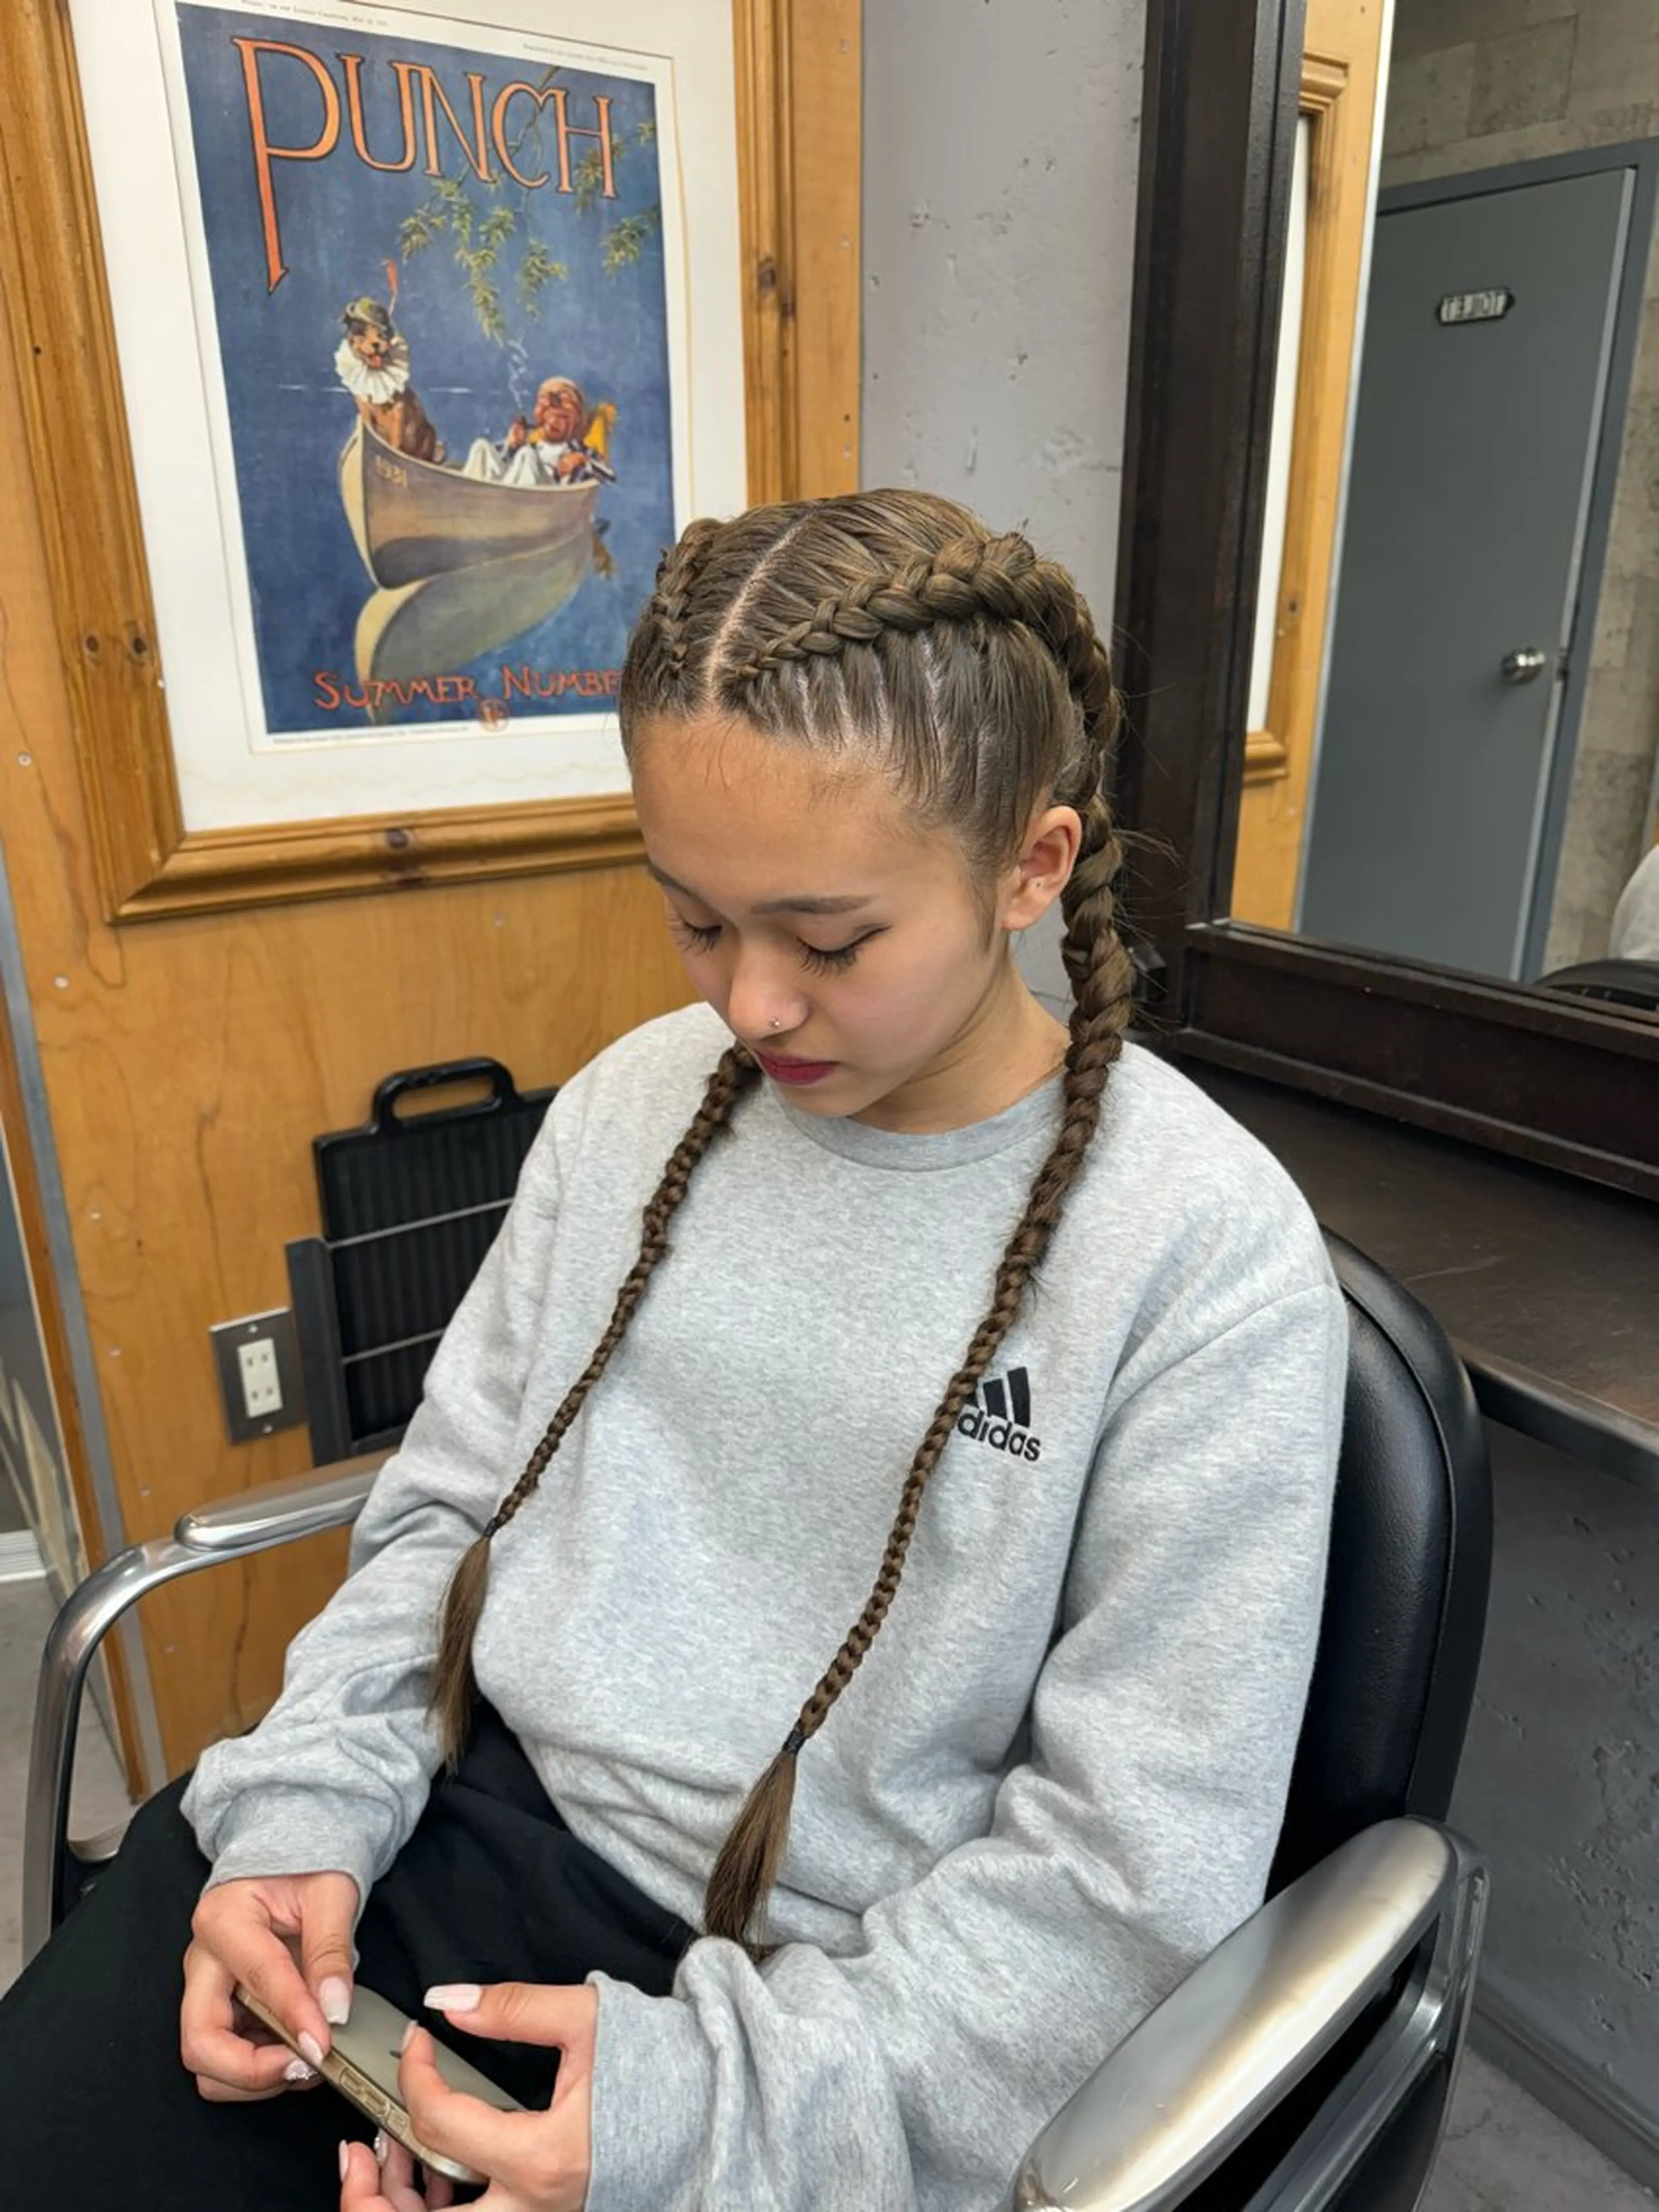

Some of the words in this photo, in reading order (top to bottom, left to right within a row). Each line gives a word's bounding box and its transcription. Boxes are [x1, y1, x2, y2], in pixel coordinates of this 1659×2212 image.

[229, 35, 619, 296] PUNCH
[313, 670, 479, 710] SUMMER
[500, 664, 624, 699] NUMBE
[957, 1407, 1041, 1462] didas
